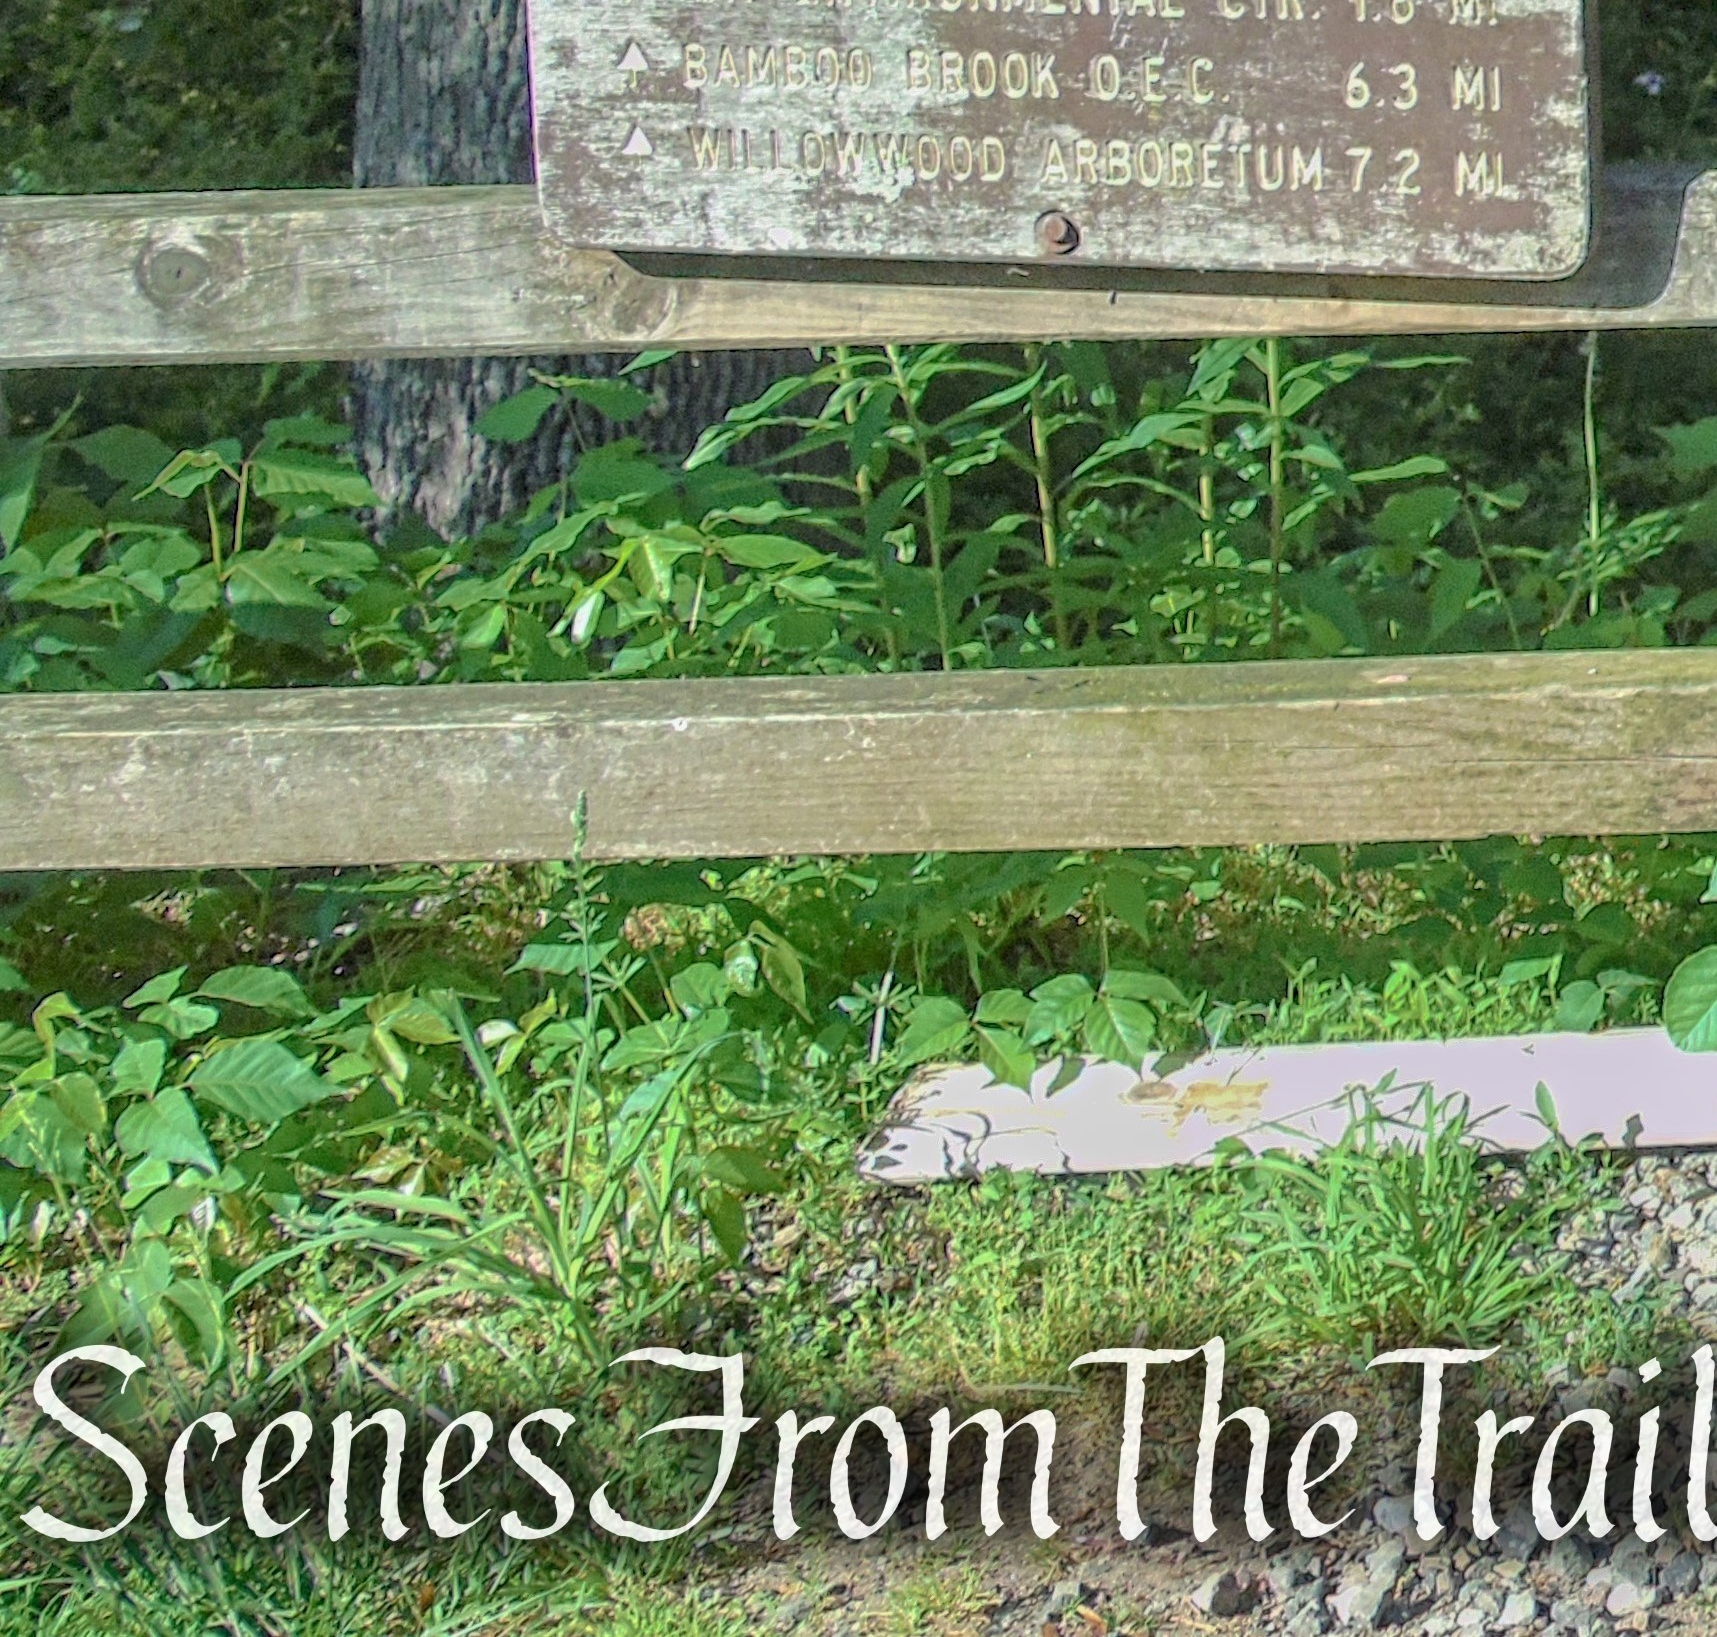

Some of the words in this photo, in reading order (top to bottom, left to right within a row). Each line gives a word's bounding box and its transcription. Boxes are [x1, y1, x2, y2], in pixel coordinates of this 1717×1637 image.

[682, 42, 873, 94] BAMBOO
[906, 49, 1060, 100] BROOK
[1088, 53, 1231, 105] O.E.C.
[1344, 62, 1419, 111] 6.3
[1450, 64, 1502, 112] MI
[686, 125, 1006, 182] WILLOWWOOD
[1040, 136, 1323, 192] ARBORETUM
[1346, 145, 1422, 194] 7.2
